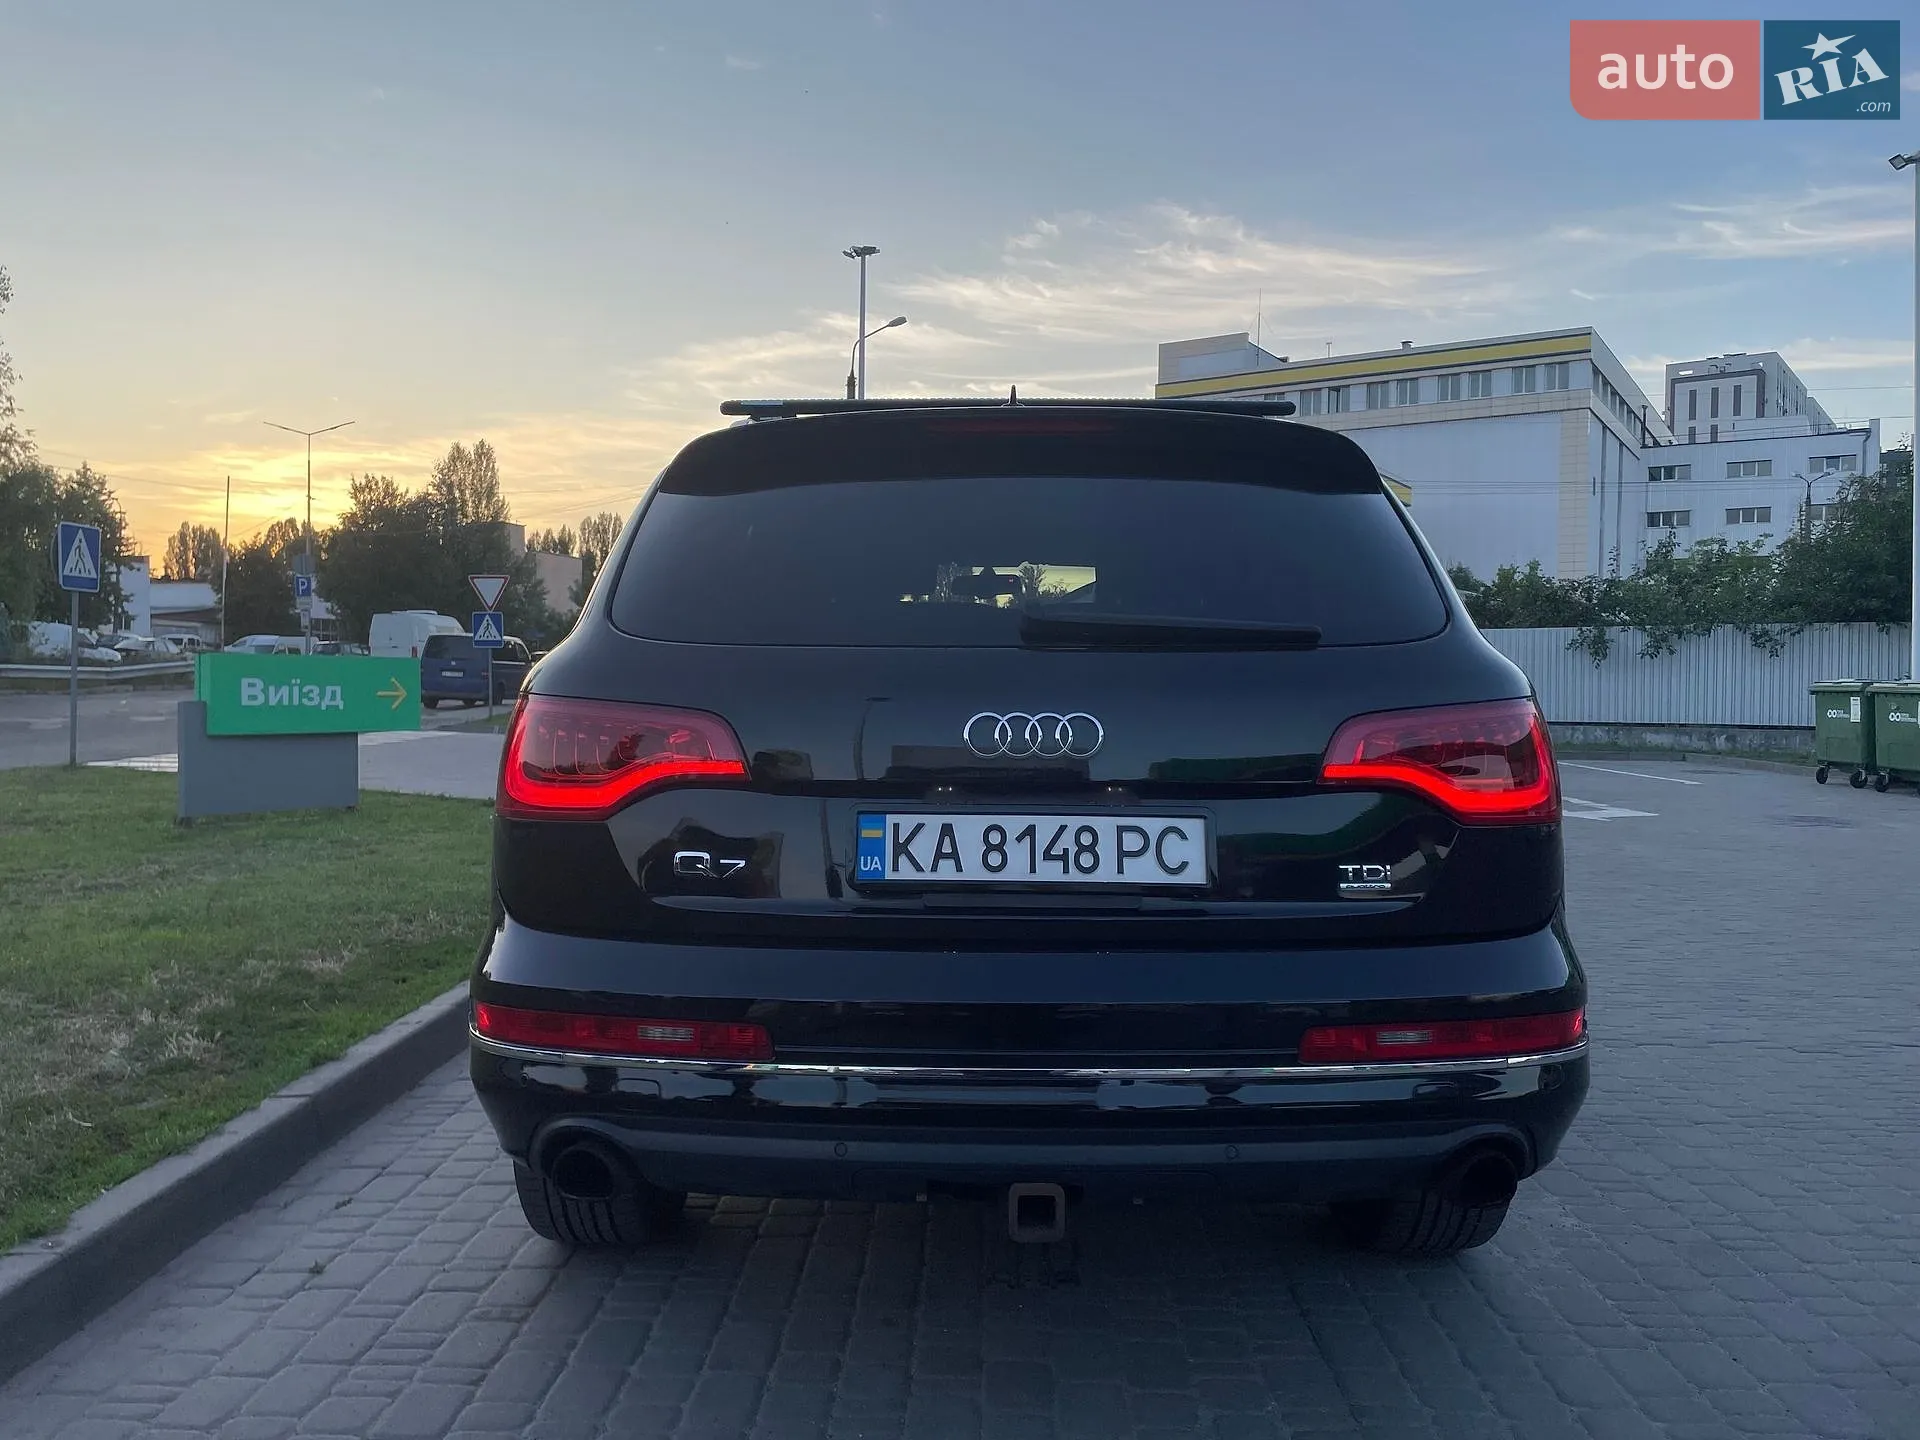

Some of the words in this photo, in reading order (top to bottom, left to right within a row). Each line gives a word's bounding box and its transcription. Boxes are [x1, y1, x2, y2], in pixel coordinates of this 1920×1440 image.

[299, 578, 308, 595] P
[241, 677, 344, 710] Виїзд
[892, 822, 964, 873] KA
[982, 824, 1100, 874] 8148
[1116, 825, 1190, 875] PC
[674, 851, 746, 878] Q7
[860, 856, 882, 871] UA
